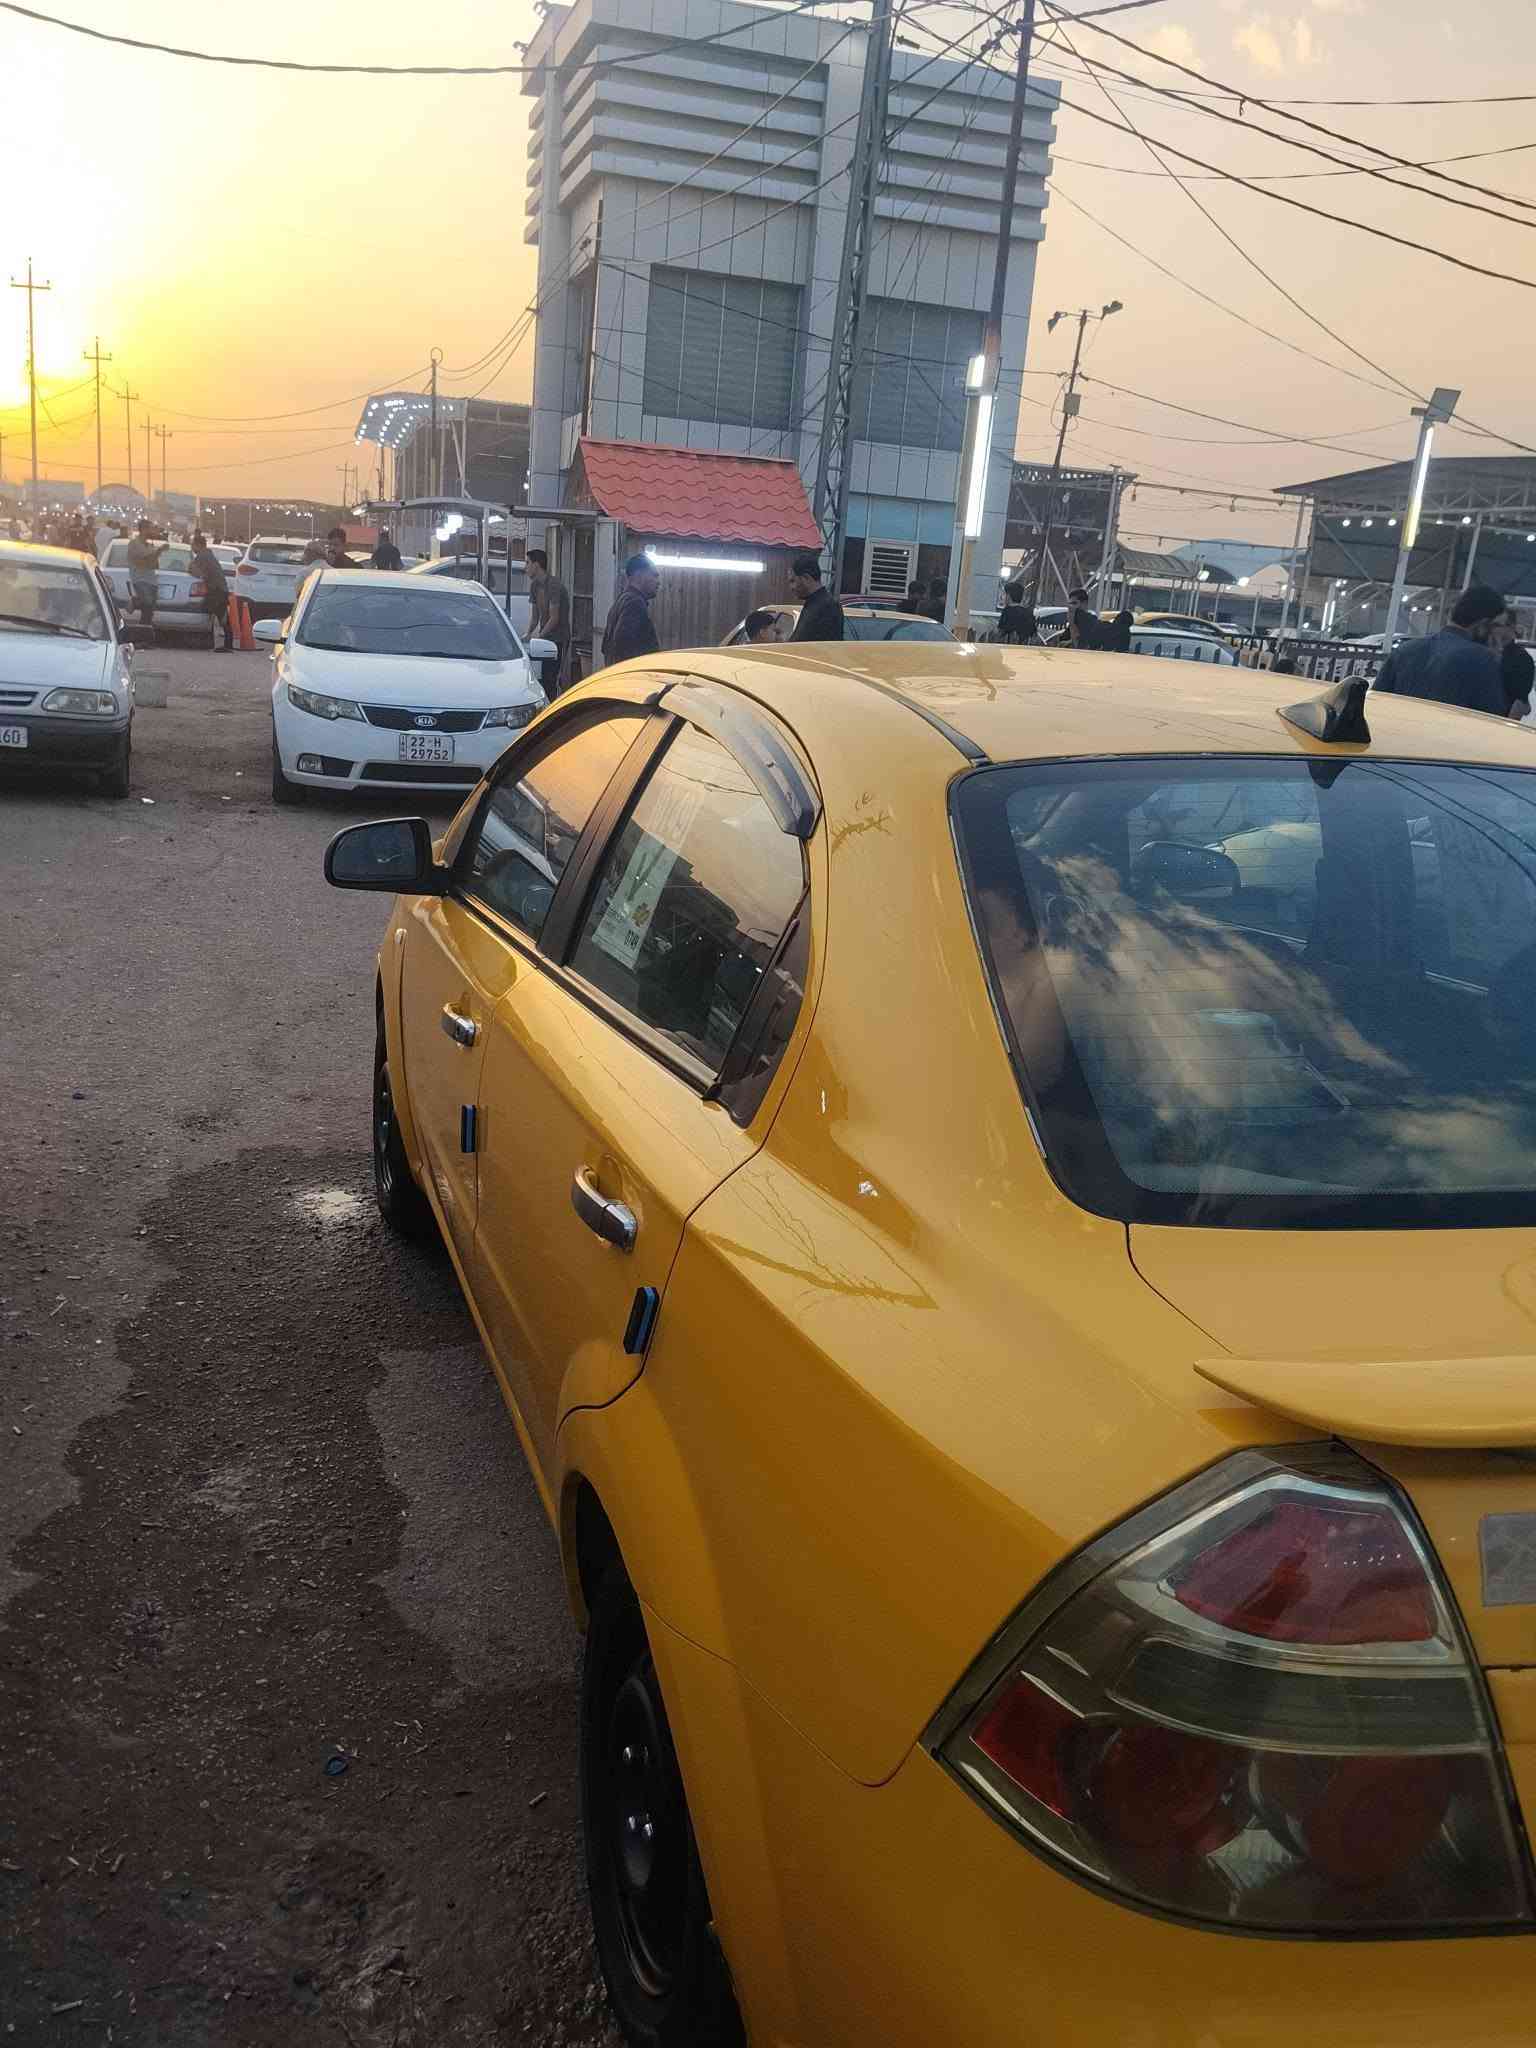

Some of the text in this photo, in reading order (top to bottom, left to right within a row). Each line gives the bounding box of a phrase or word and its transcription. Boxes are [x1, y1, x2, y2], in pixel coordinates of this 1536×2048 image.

[417, 716, 434, 727] KIA
[0, 729, 20, 744] 60
[411, 736, 425, 747] 22
[434, 737, 441, 747] H
[410, 748, 449, 760] 29752
